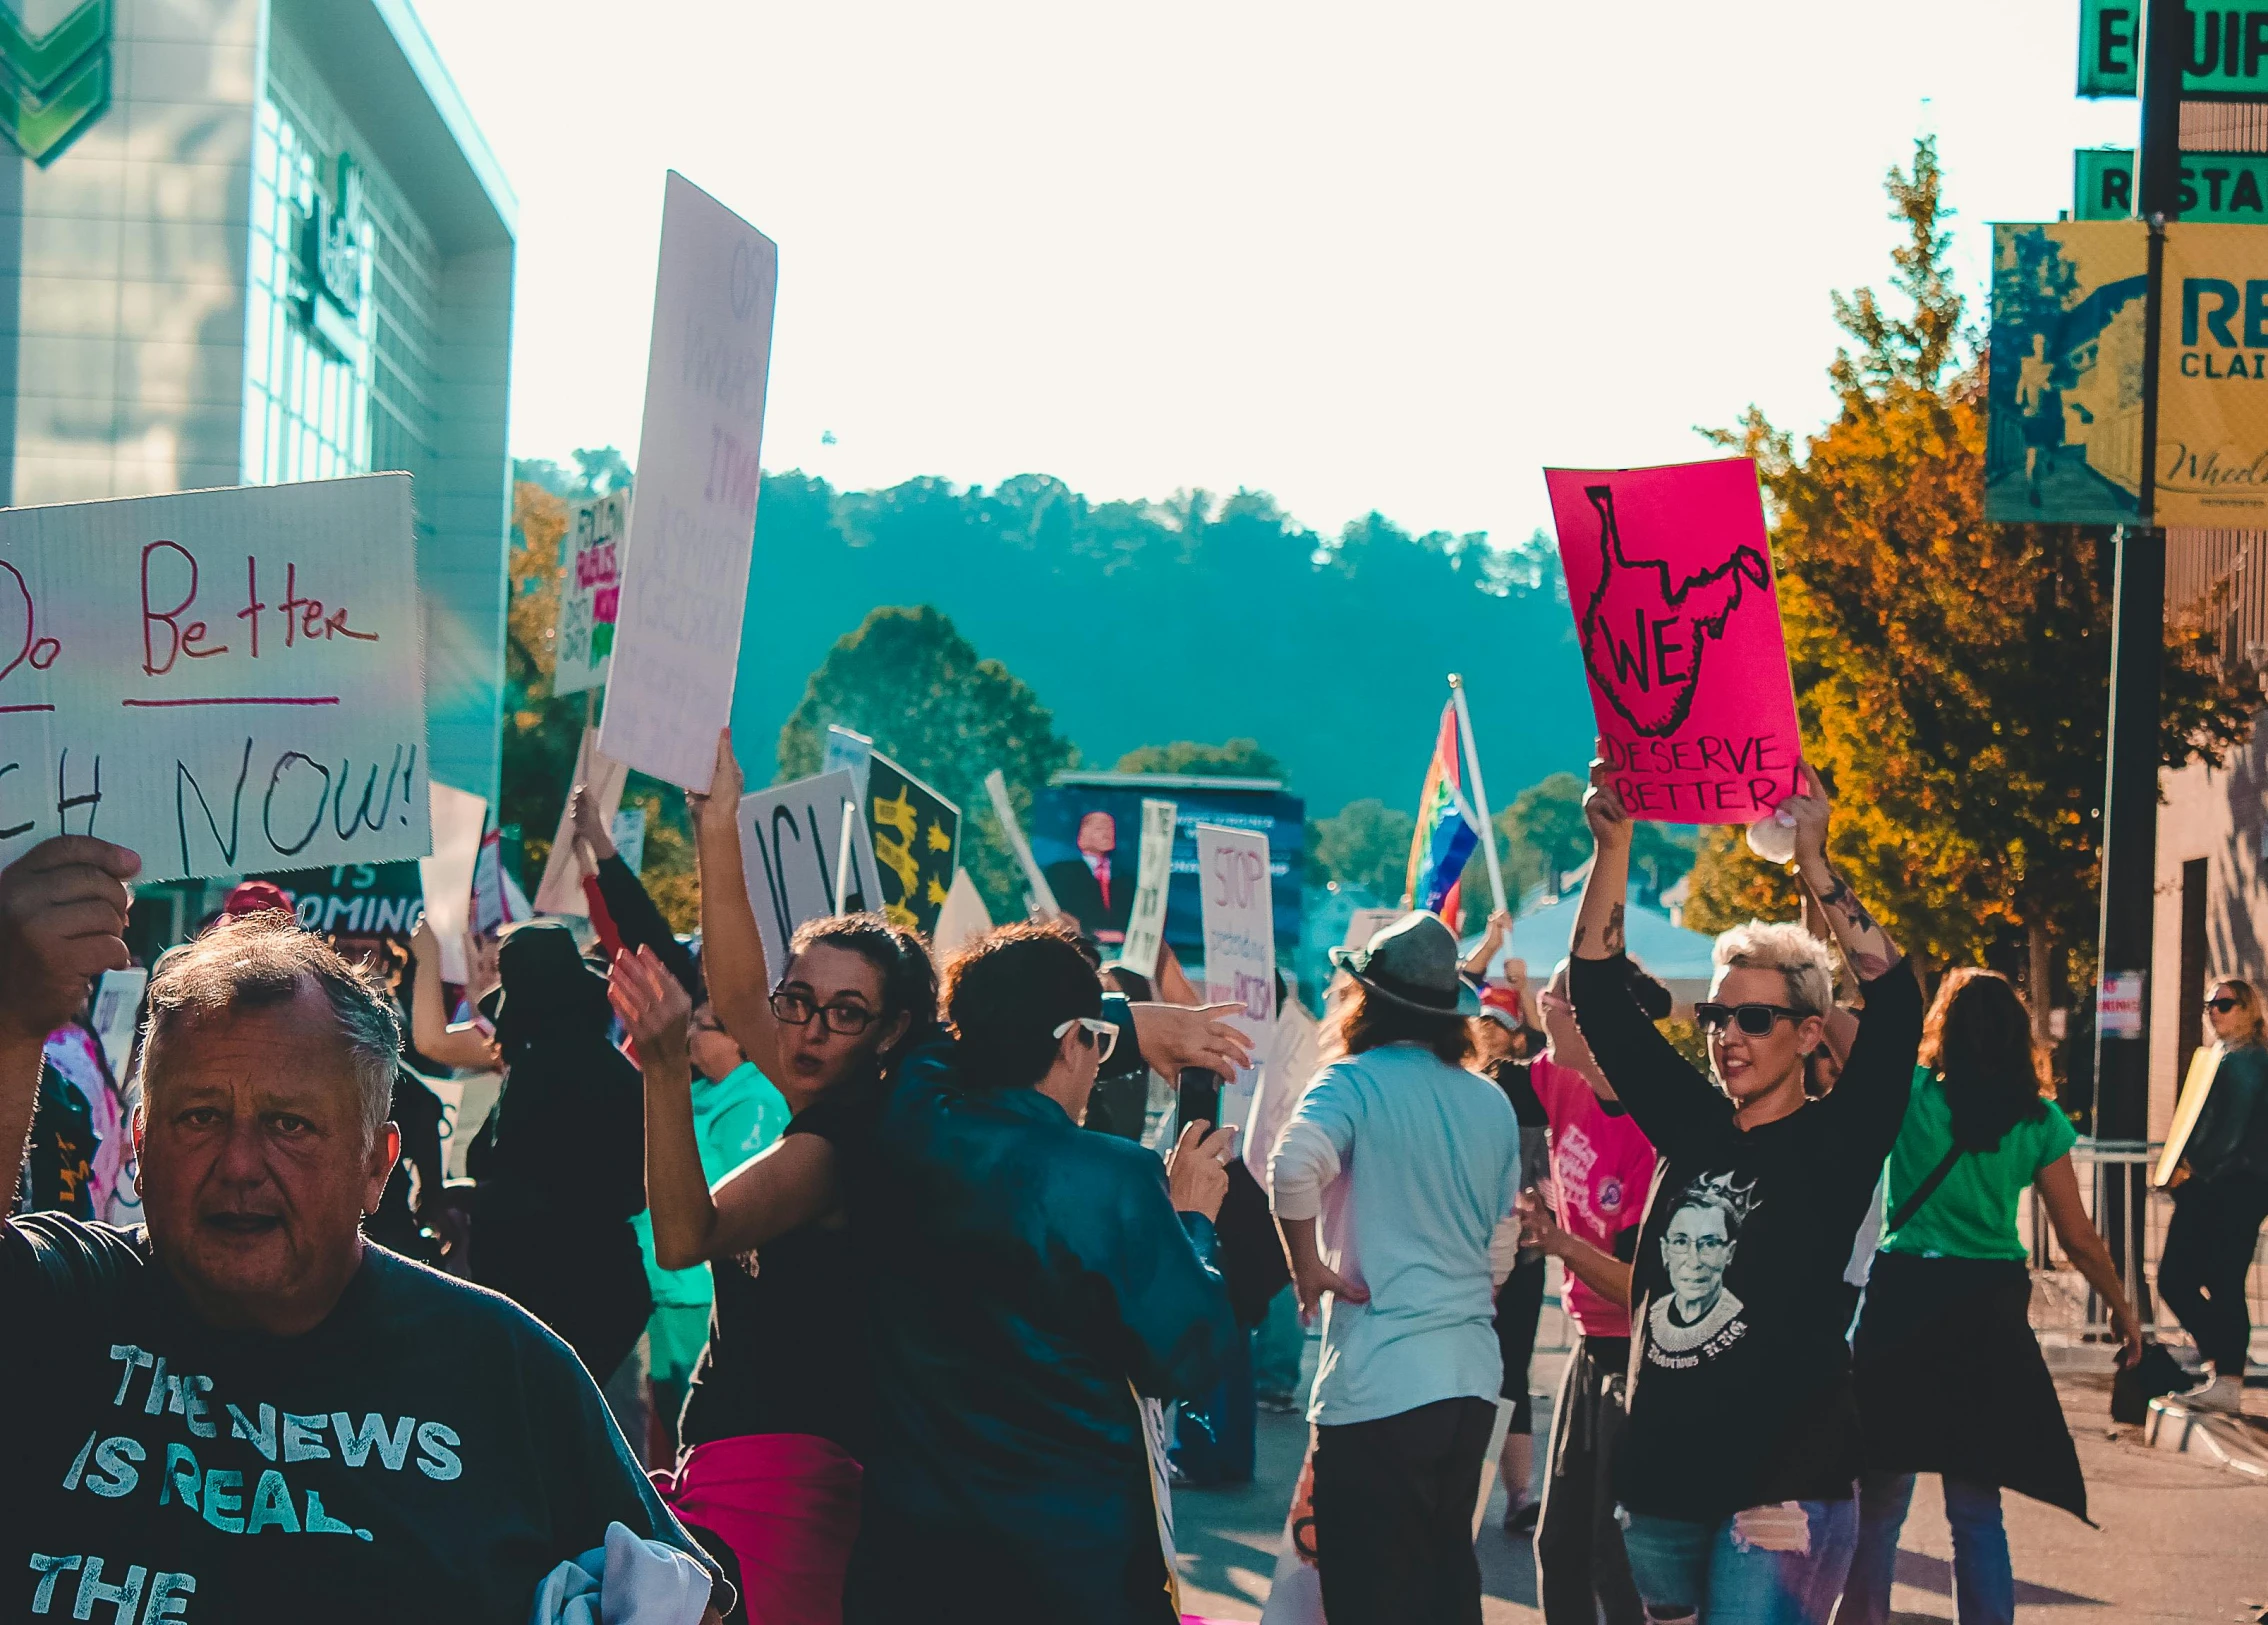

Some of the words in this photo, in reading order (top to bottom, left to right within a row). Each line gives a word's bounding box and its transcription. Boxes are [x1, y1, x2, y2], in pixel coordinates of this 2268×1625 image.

[2099, 9, 2268, 77] EUIP
[2102, 168, 2264, 212] RSTA
[2181, 278, 2268, 348] RE
[2181, 352, 2265, 379] CLAI
[1599, 608, 1687, 693] WE
[1603, 733, 1788, 774] DESERVE
[177, 736, 417, 878] NOW!
[283, 892, 425, 934] OMIN
[226, 1402, 462, 1481] NEWS
[63, 1431, 147, 1497] IS
[160, 1443, 373, 1541] REAL.
[30, 1553, 196, 1625] THE
